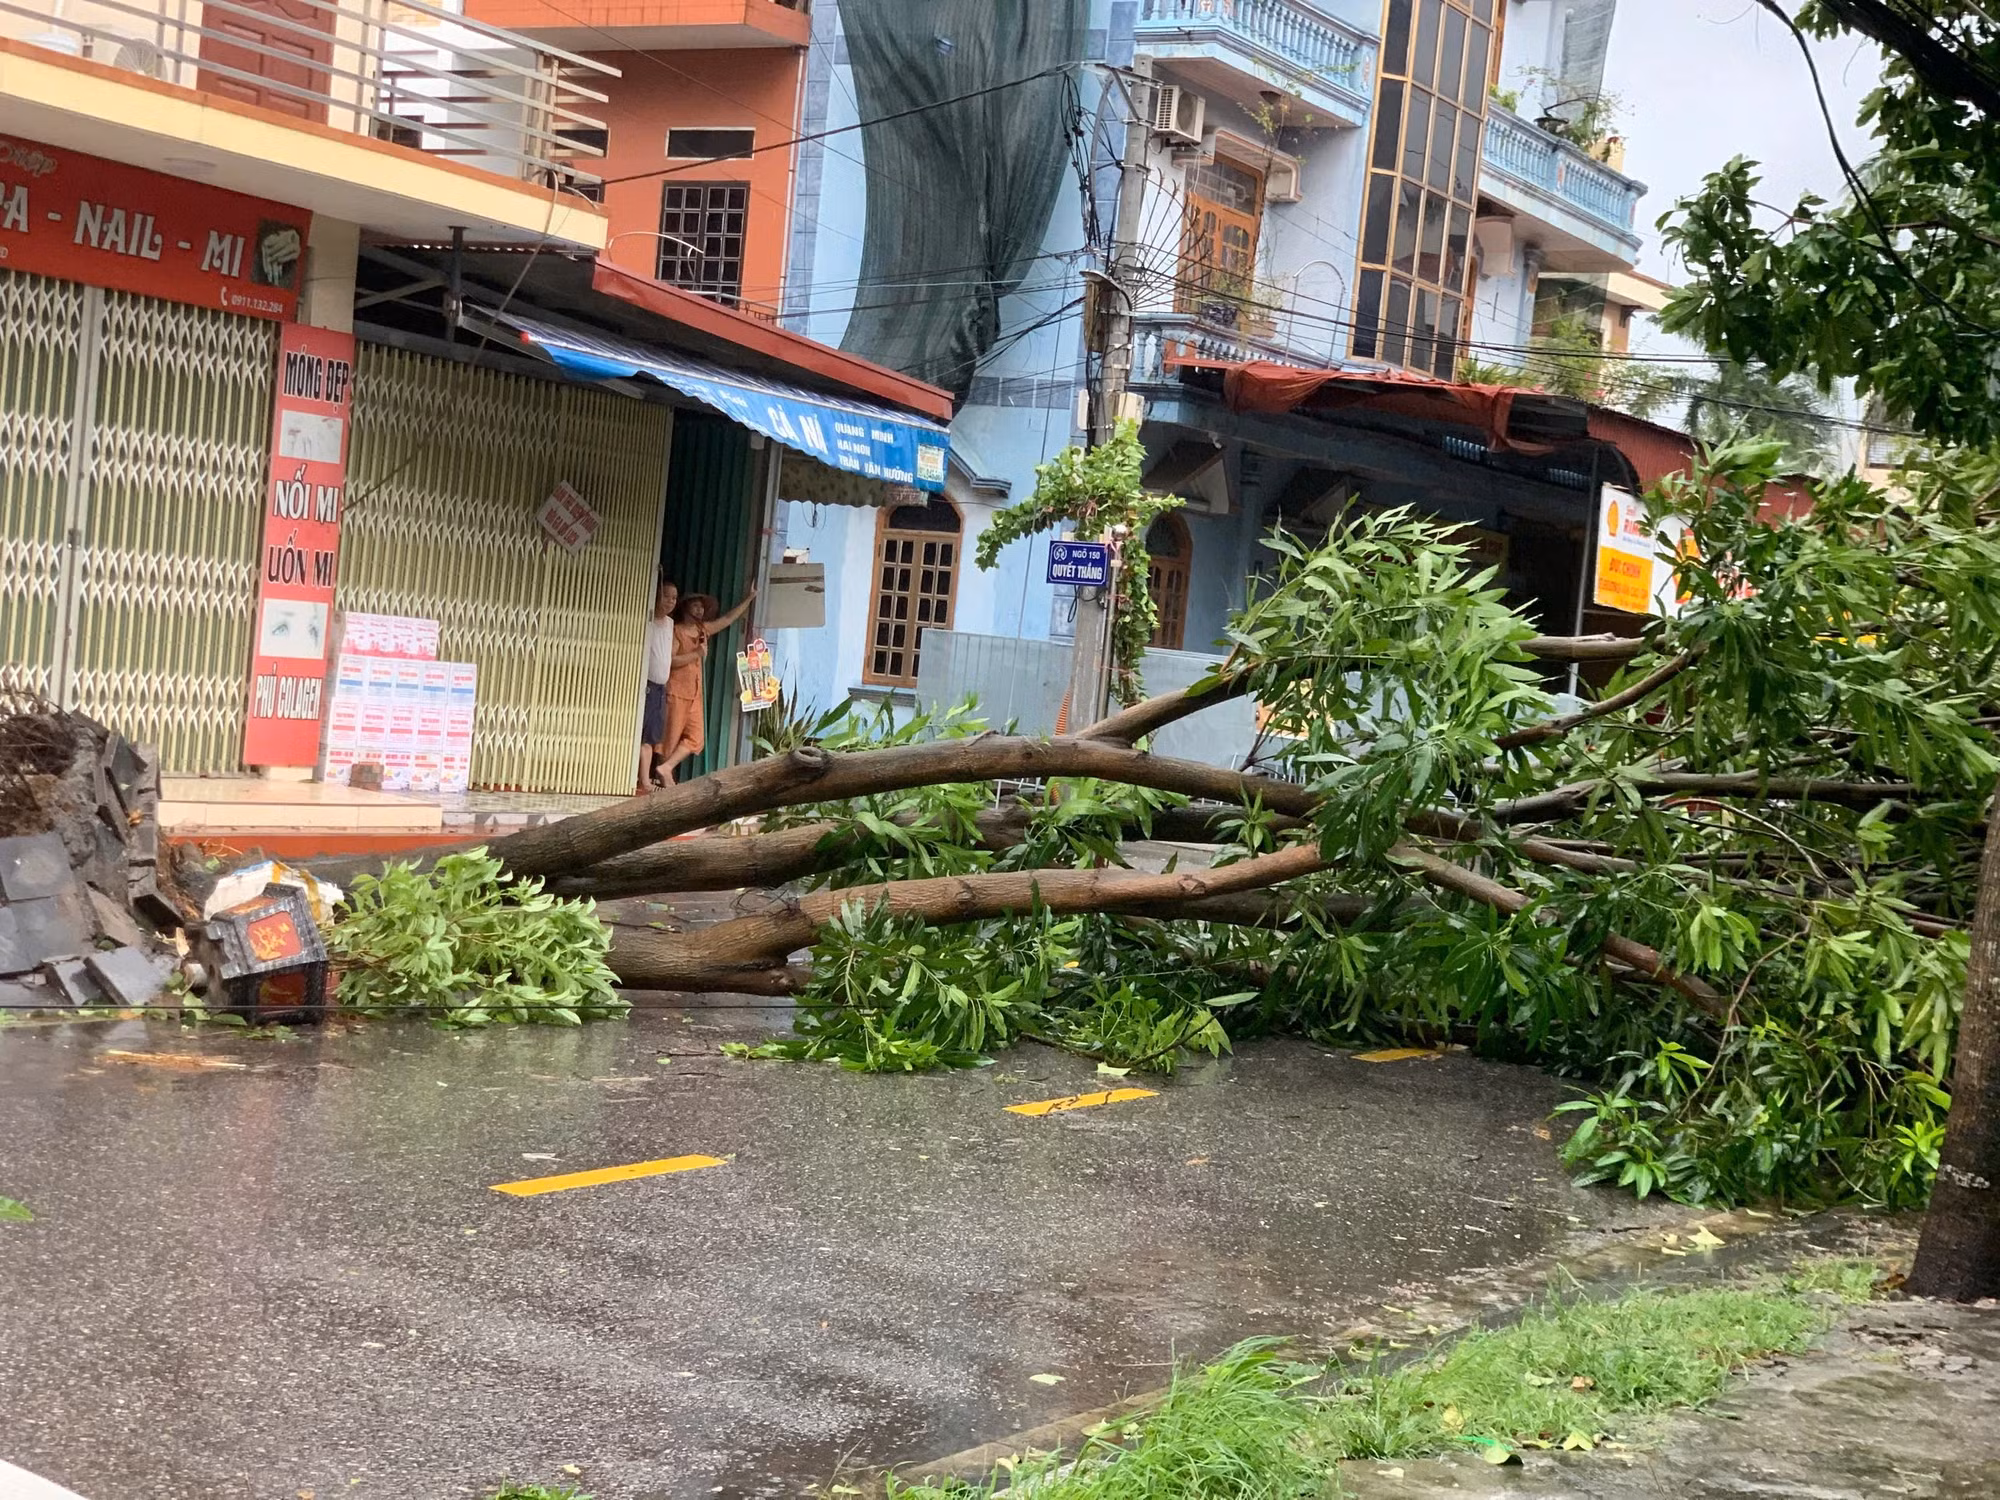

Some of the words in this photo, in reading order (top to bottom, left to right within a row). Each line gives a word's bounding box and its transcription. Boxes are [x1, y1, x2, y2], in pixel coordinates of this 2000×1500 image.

[0, 181, 29, 233] A
[73, 200, 163, 261] NAIL
[200, 230, 246, 278] MI
[283, 344, 323, 401] MÓNG
[324, 358, 351, 414] ĐẸP
[834, 421, 865, 438] QUANG
[273, 463, 312, 520] NỐI
[314, 484, 339, 524] MI
[267, 528, 309, 586] UỐN
[312, 550, 335, 589] MI
[1052, 560, 1077, 578] QUYẾT
[1072, 548, 1088, 559] NGÕ
[1088, 551, 1101, 560] 150
[277, 675, 323, 721] COLAGEN
